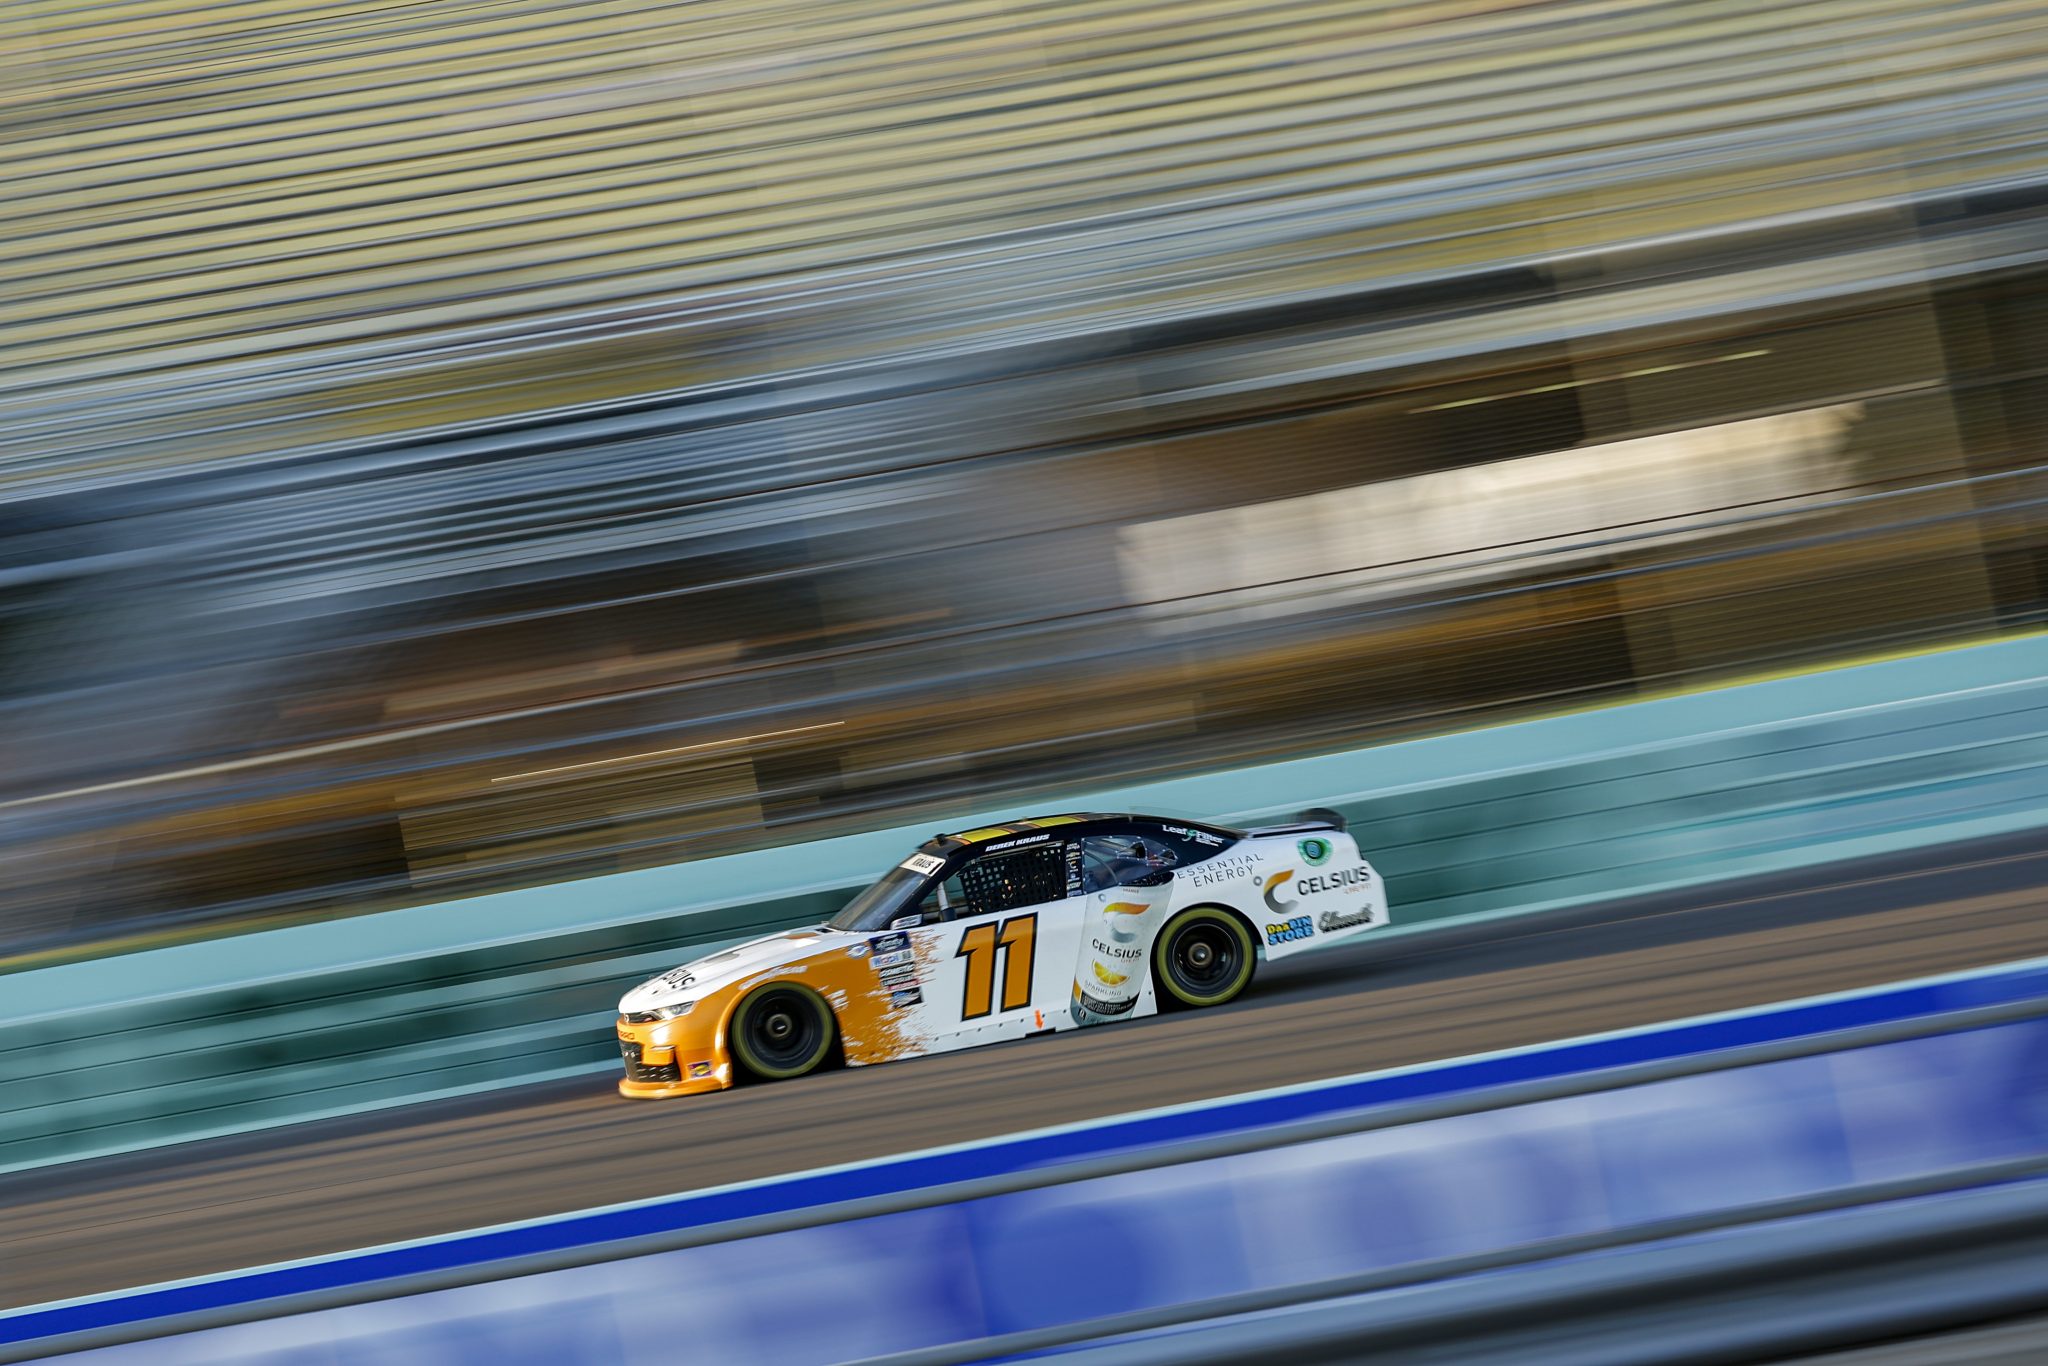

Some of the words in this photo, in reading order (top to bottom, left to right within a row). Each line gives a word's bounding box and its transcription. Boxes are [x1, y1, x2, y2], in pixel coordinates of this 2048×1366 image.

[1162, 825, 1188, 835] Leaf
[985, 840, 1016, 852] DEREK
[1015, 833, 1050, 846] KRAUS
[1177, 853, 1263, 879] ESSENTIAL
[1193, 864, 1255, 888] ENERGY
[1297, 866, 1370, 895] CELSIUS
[1267, 926, 1315, 946] STORE
[1092, 938, 1142, 959] CELSIUS
[953, 911, 1039, 1022] 11
